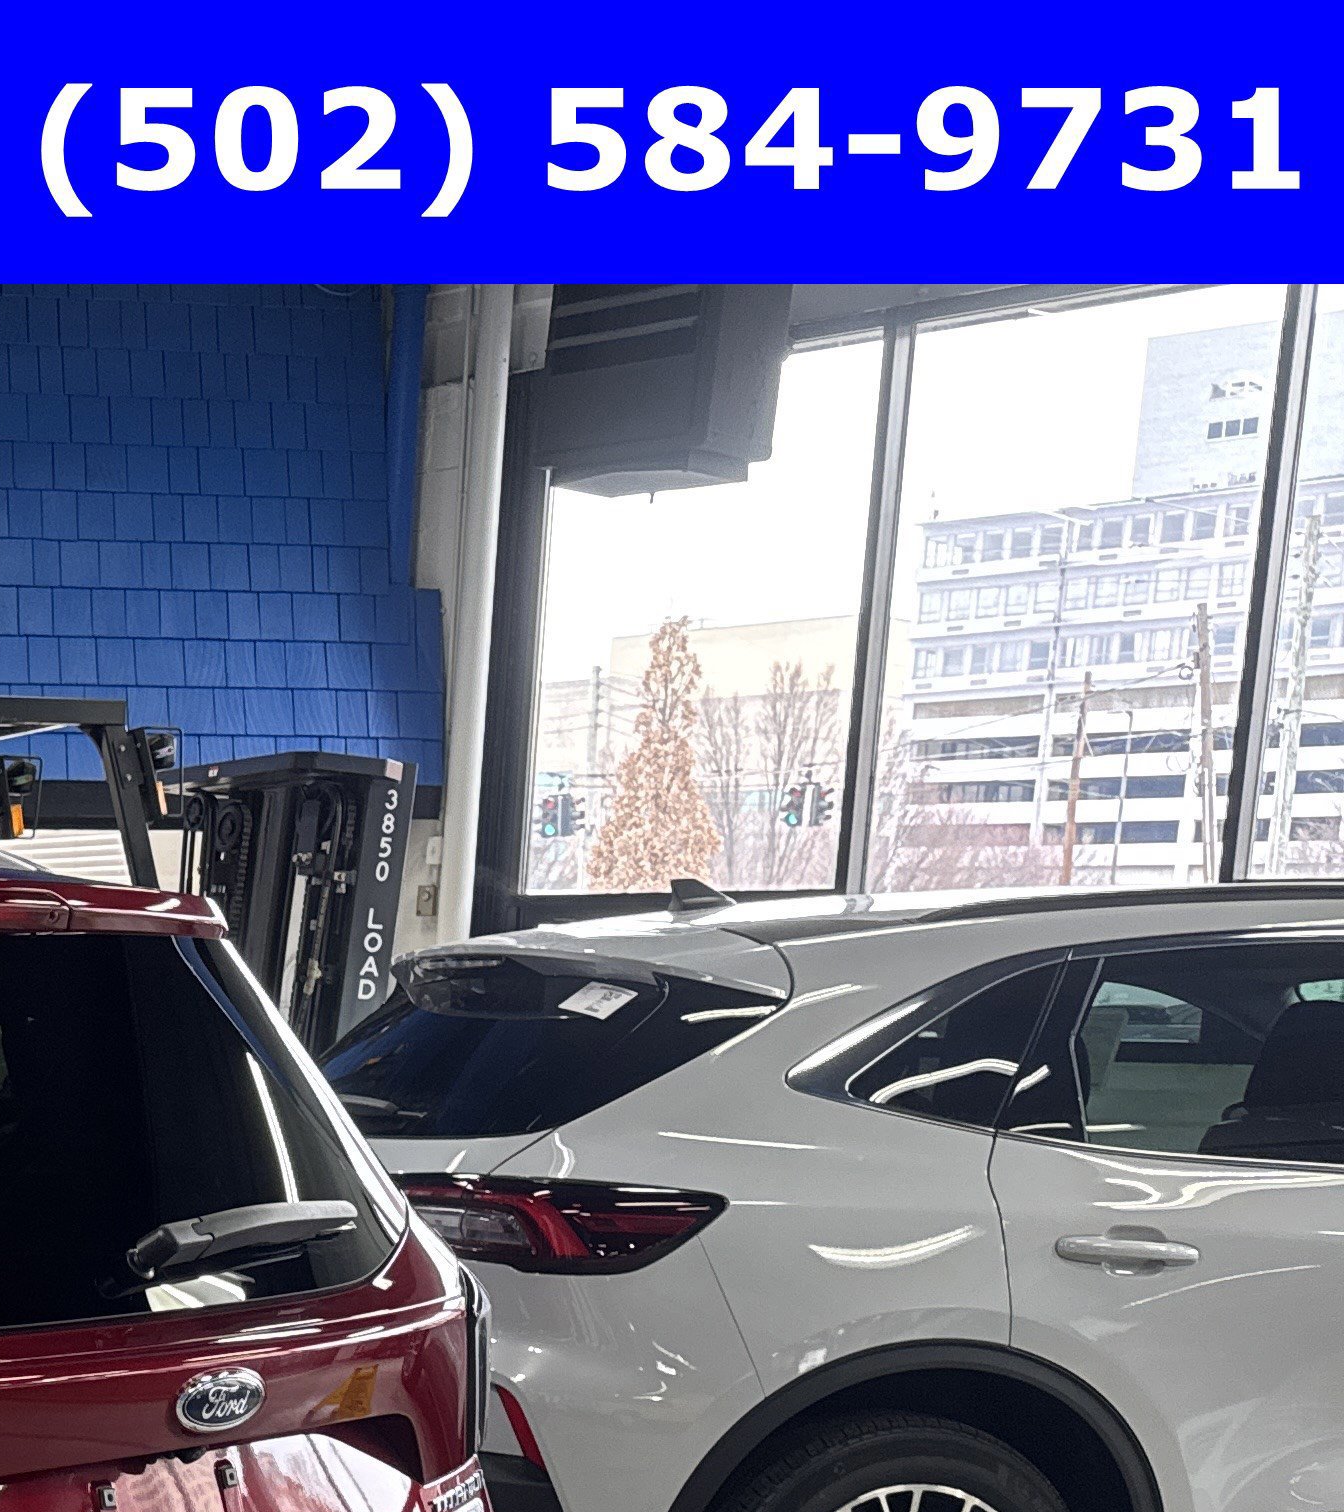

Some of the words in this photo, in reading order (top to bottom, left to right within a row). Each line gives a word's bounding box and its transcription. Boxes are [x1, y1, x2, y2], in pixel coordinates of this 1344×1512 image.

[374, 789, 398, 882] 3850
[358, 908, 384, 1000] LOAD
[201, 1384, 251, 1420] Ford
